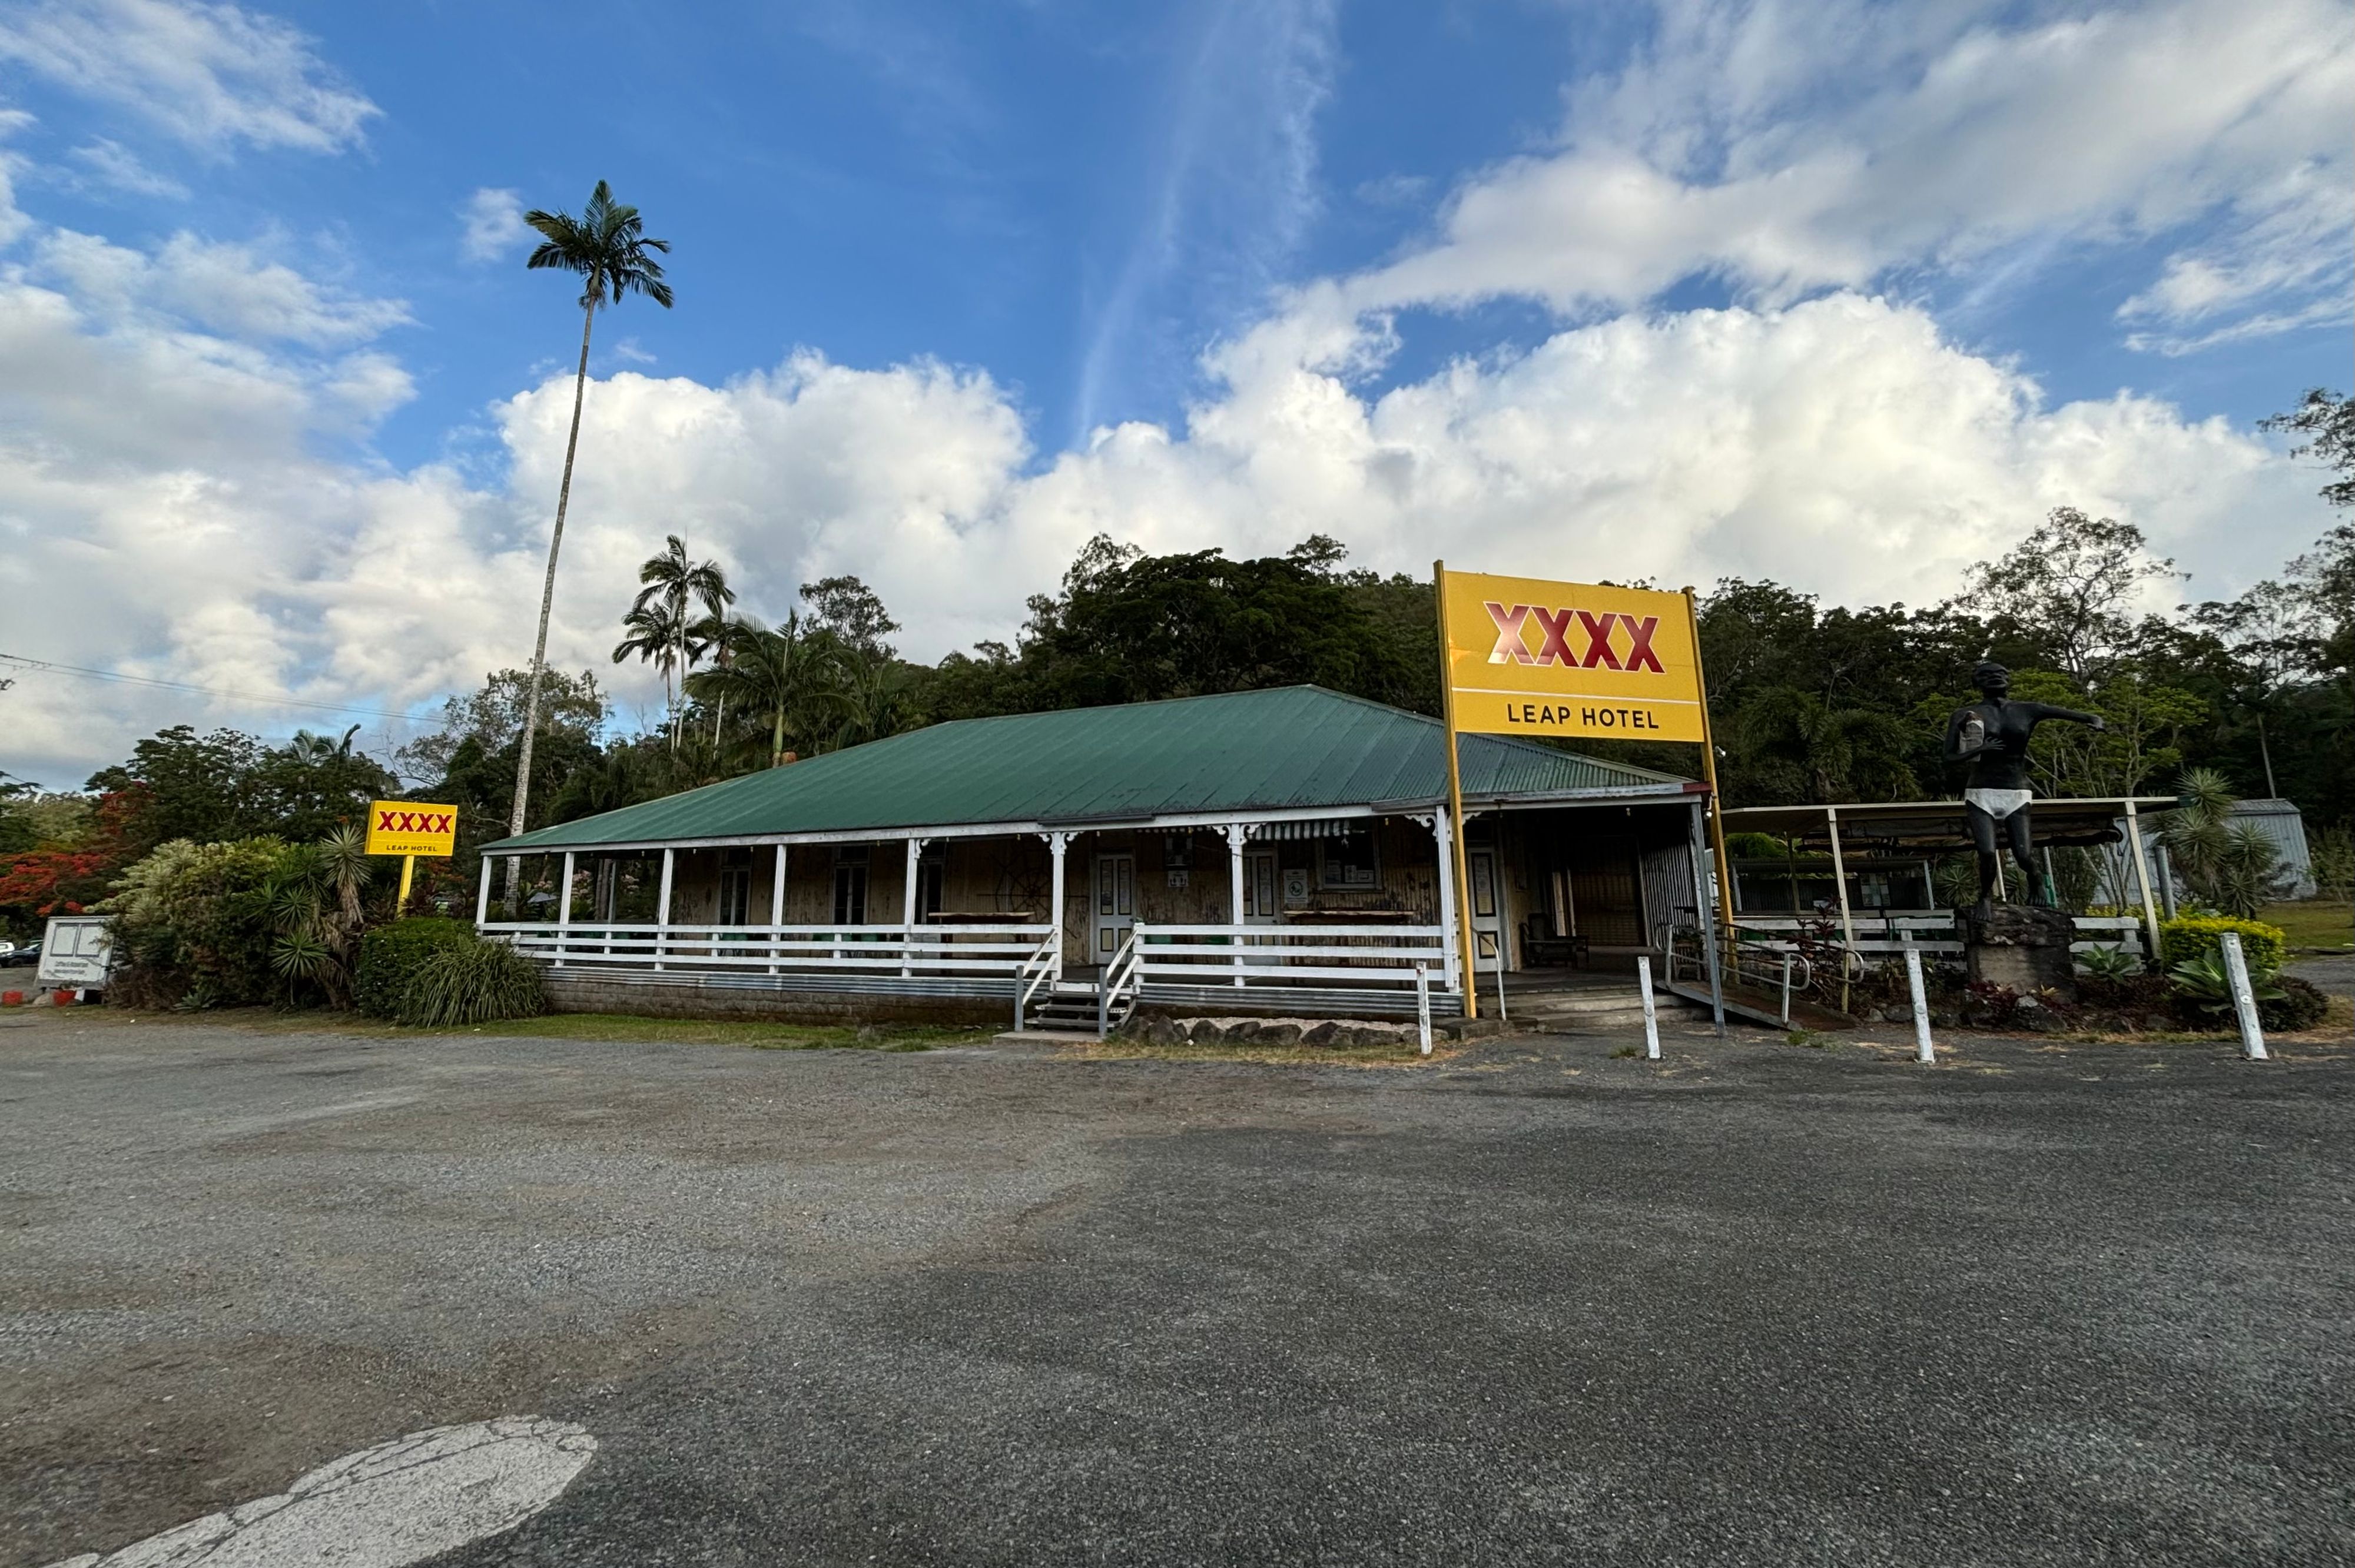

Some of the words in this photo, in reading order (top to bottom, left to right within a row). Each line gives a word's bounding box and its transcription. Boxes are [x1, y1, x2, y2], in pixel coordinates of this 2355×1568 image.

[1483, 601, 1666, 675] XXXX
[1507, 703, 1571, 725] LEAP
[1582, 707, 1659, 729] HOTEL
[377, 811, 453, 833] XXXX
